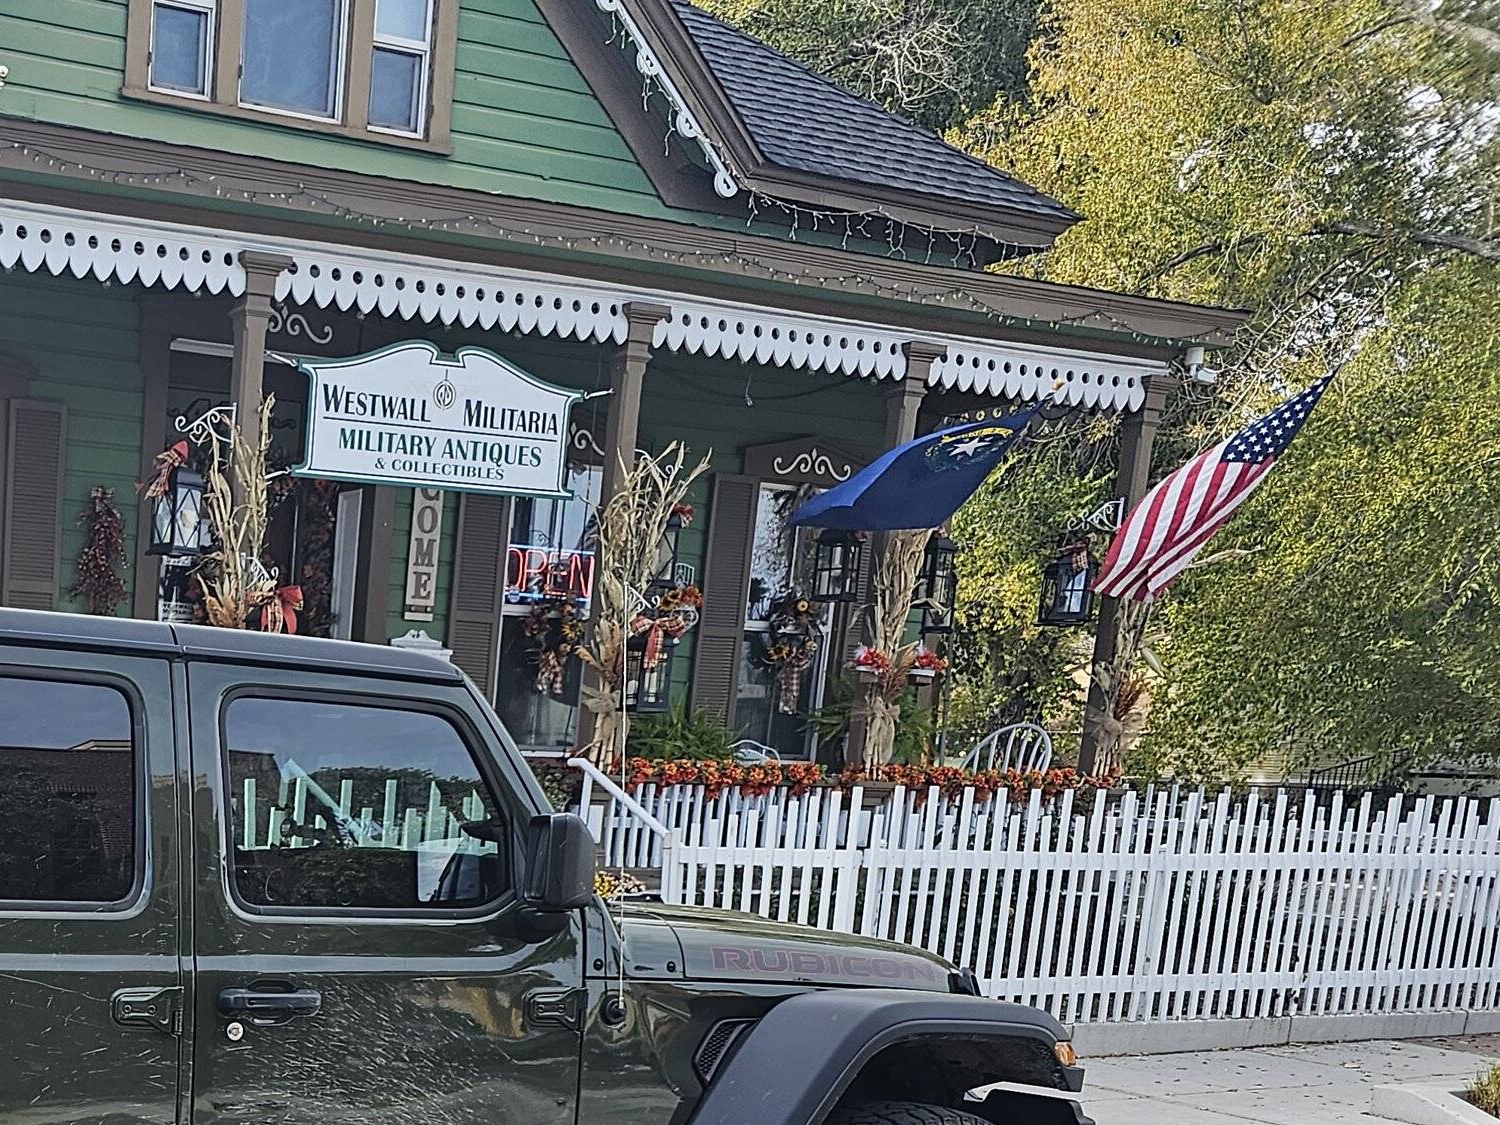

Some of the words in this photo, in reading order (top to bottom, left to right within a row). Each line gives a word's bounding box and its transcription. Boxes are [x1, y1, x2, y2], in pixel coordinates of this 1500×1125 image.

[323, 383, 431, 422] WESTWALL
[464, 399, 558, 435] MILITARIA
[339, 428, 436, 457] MILITARY
[441, 439, 542, 467] ANTIQUES
[374, 458, 385, 470] &
[392, 459, 504, 480] COLLECTIBLES
[507, 548, 594, 598] OPEN
[710, 945, 938, 982] RUBICON
